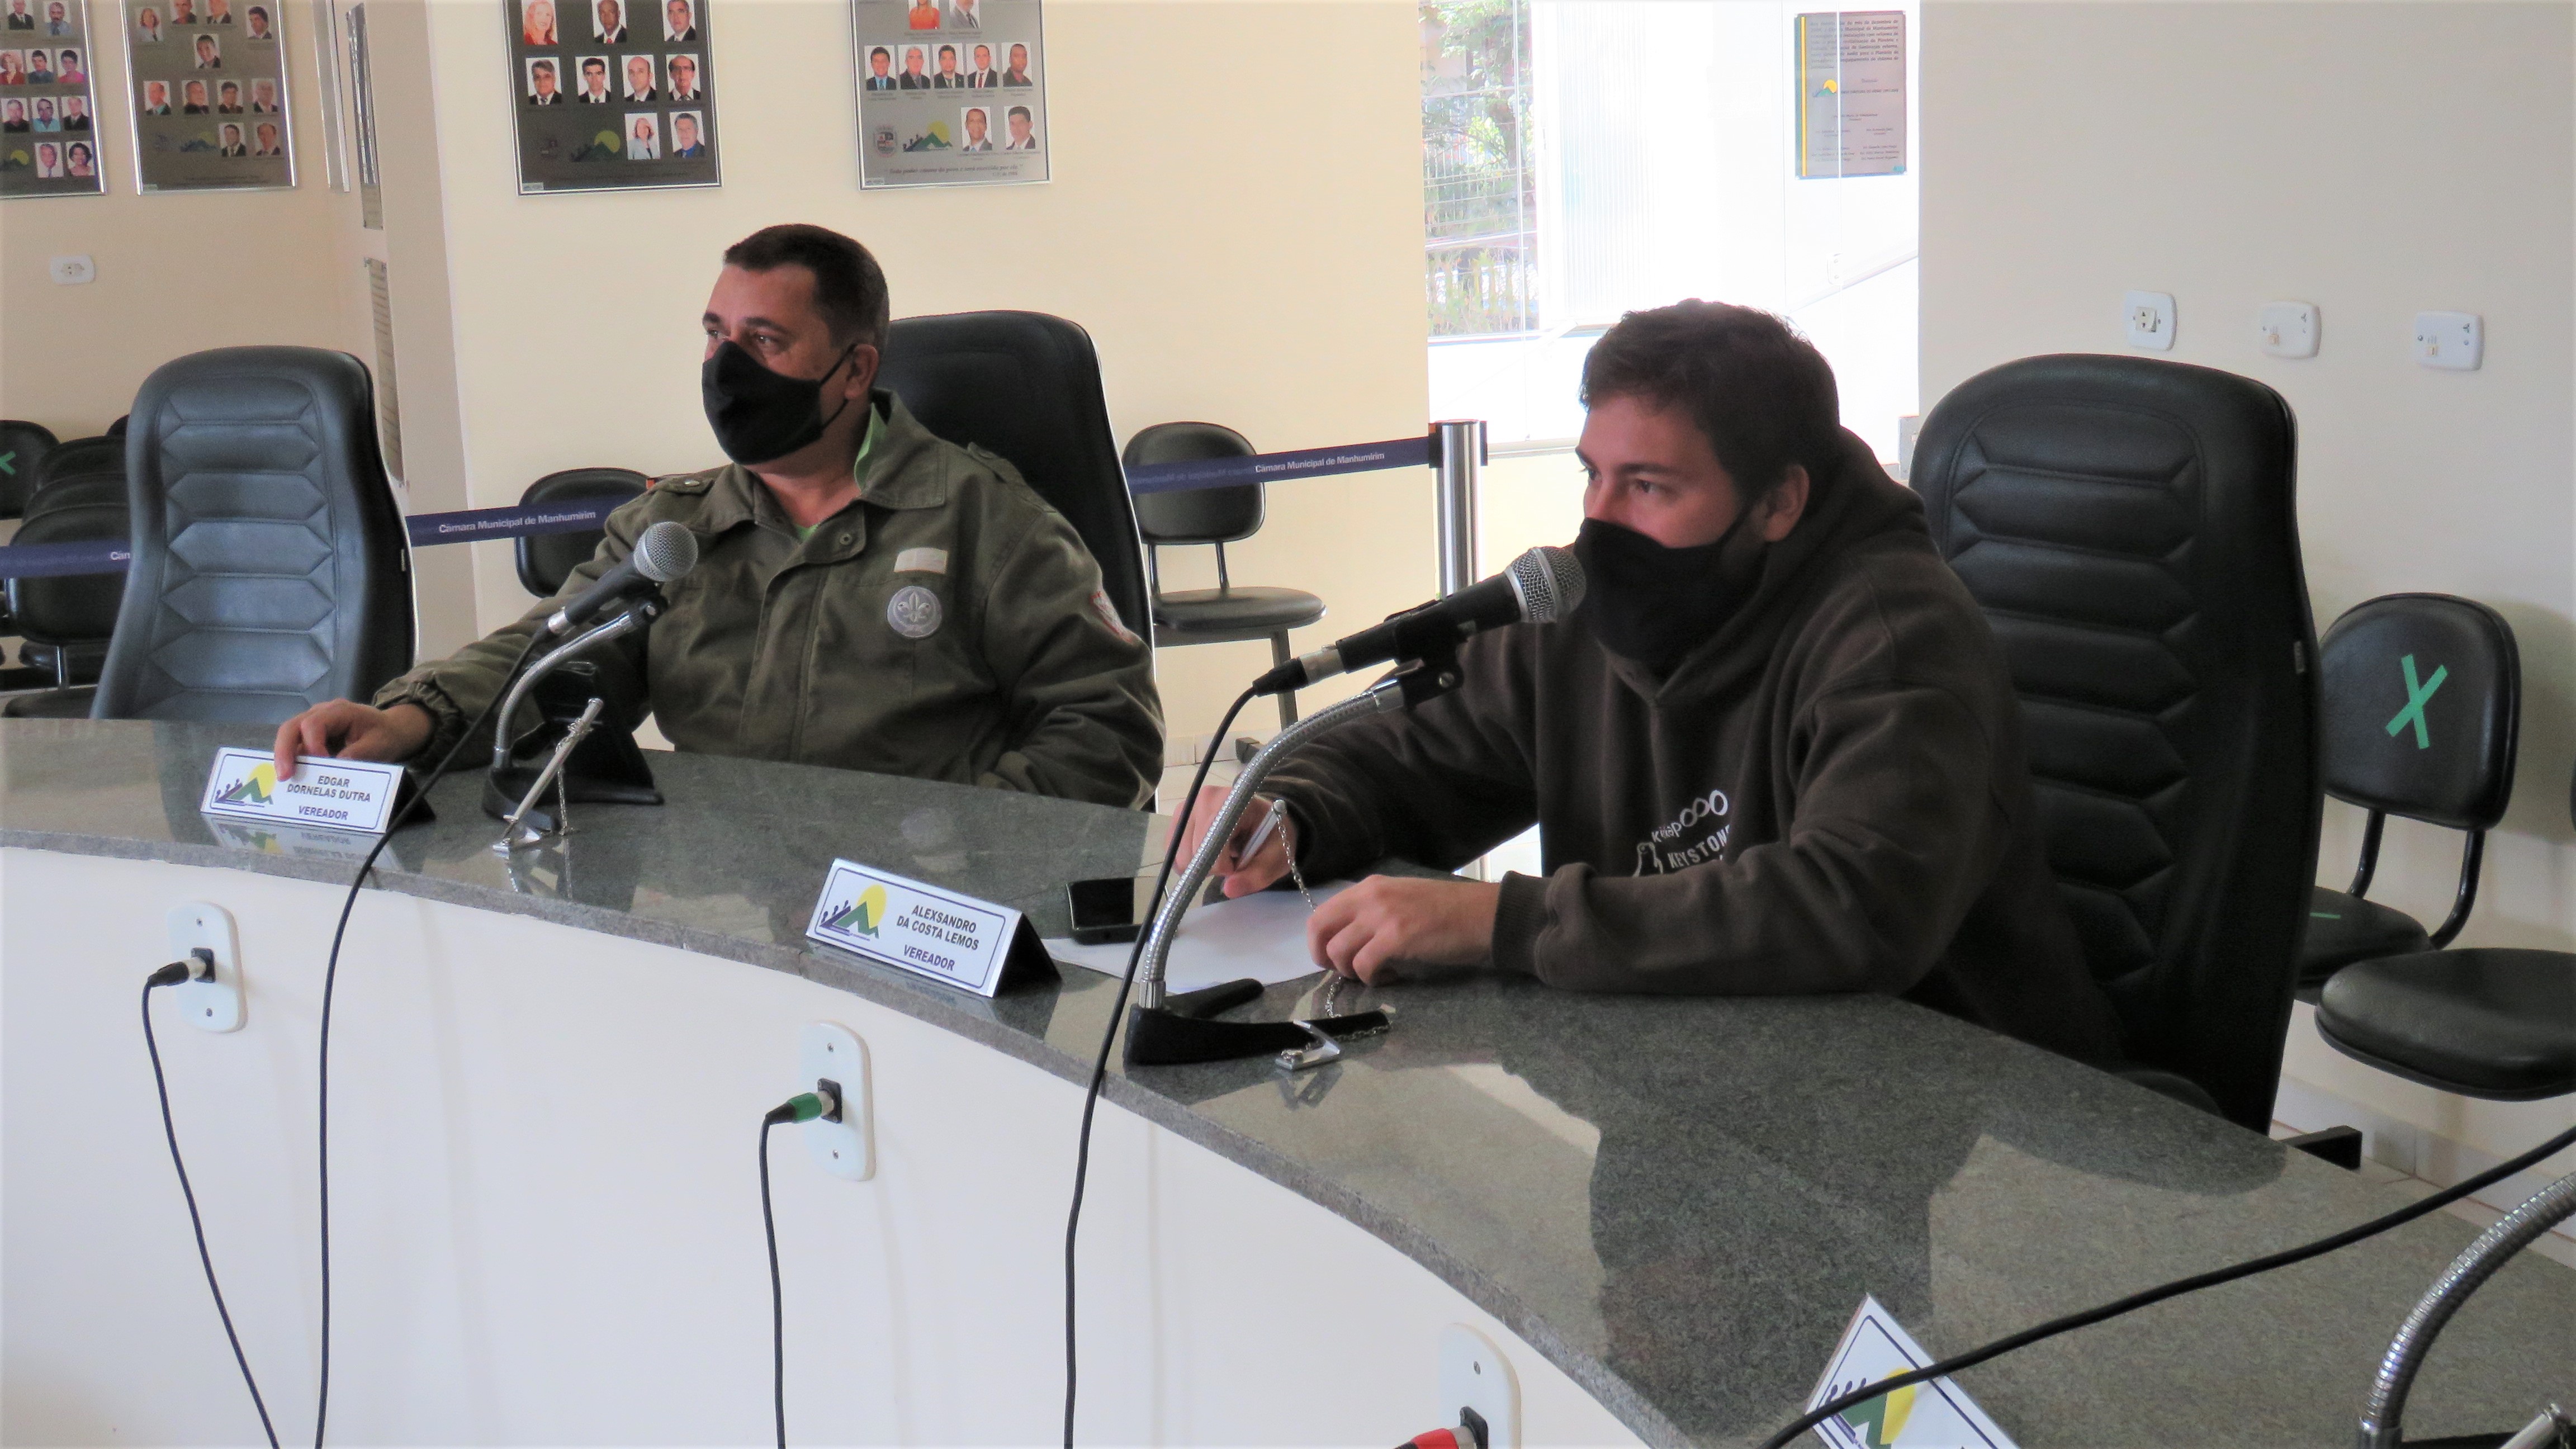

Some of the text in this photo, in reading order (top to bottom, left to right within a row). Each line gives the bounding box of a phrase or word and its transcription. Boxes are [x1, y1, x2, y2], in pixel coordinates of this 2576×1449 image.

[1287, 457, 1324, 470] Municipal
[1337, 452, 1385, 464] Manhumirim
[478, 518, 523, 528] Municipal
[525, 516, 537, 525] de
[538, 511, 596, 523] Manhumirim
[318, 775, 351, 788] EDGAR
[287, 783, 371, 803] DORNELAS DUTRA
[299, 805, 349, 820] VEREADOR
[911, 905, 977, 934] ALEXSANDRO
[896, 915, 979, 951] DA COSTA LEMOS
[903, 944, 955, 972] VEREADOR
